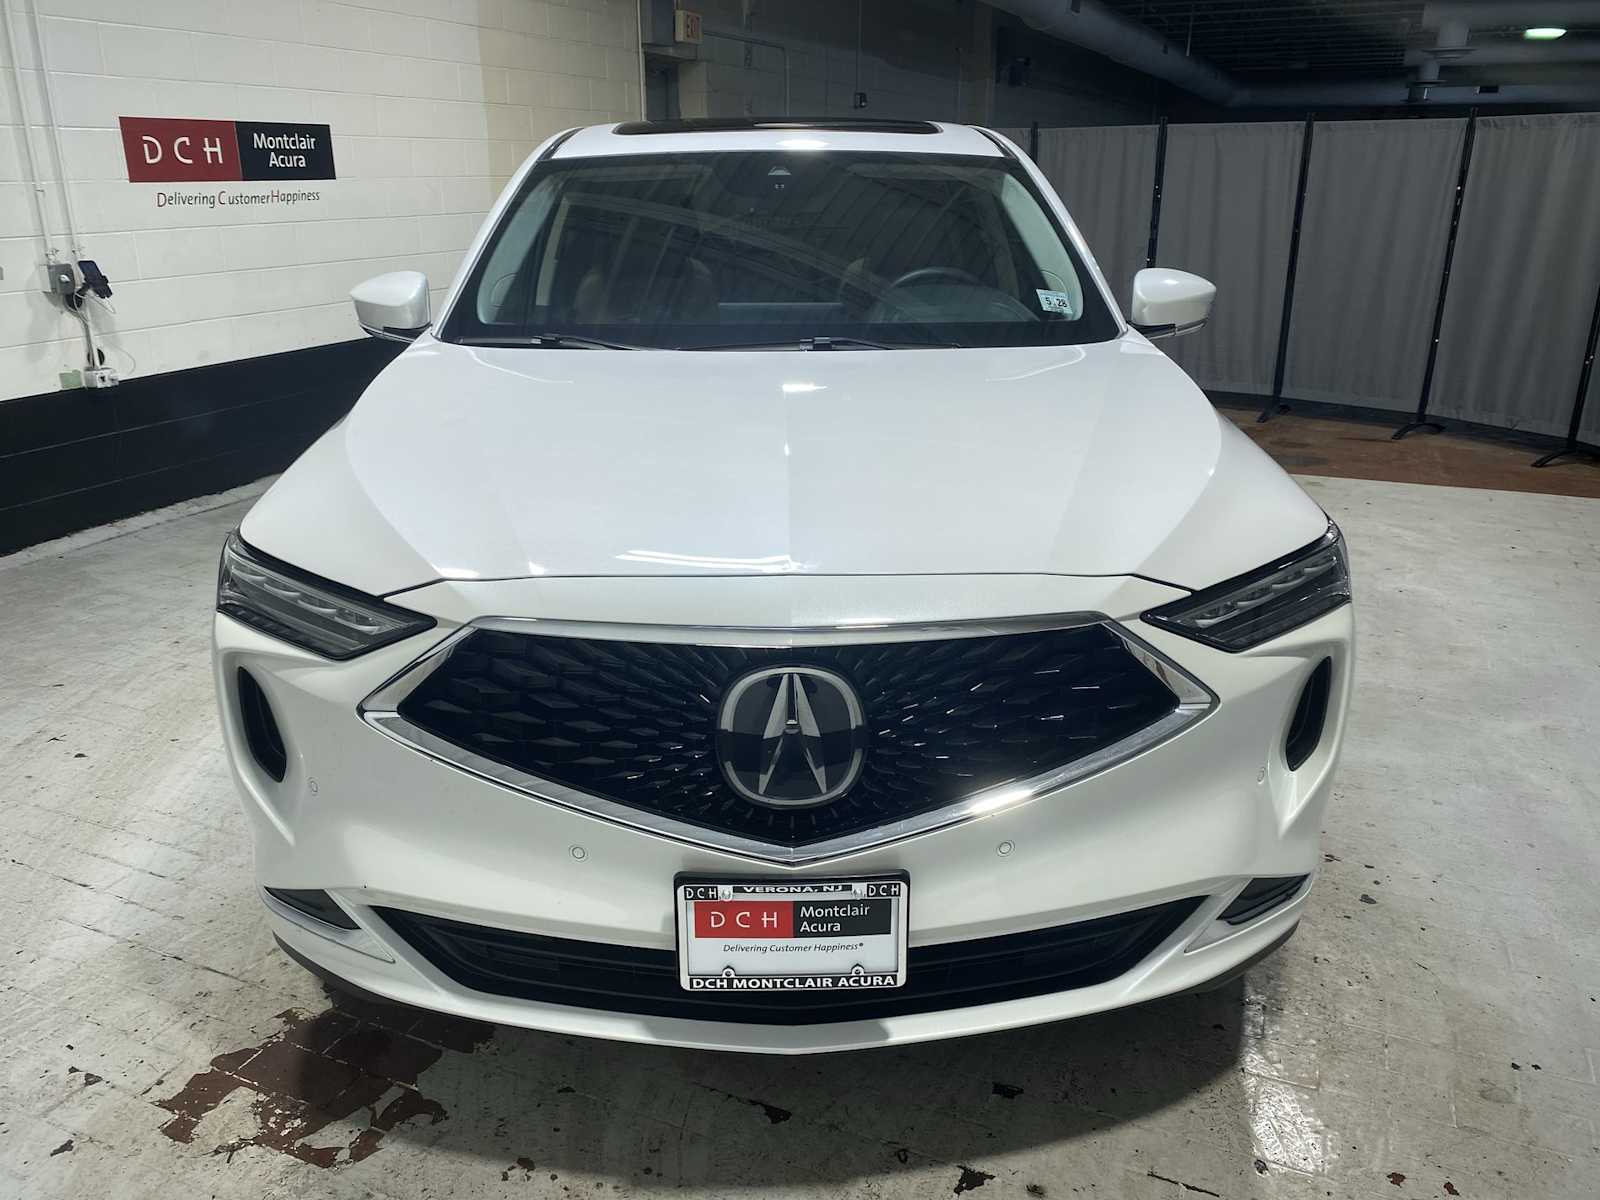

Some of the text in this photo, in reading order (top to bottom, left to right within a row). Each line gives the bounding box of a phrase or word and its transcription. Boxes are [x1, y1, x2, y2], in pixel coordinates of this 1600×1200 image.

[253, 133, 316, 150] Montclair
[142, 135, 223, 164] DCH
[269, 152, 306, 168] Acura
[157, 192, 215, 208] Delivering
[271, 190, 320, 206] Happiness
[686, 888, 717, 899] DCH
[868, 884, 900, 896] DCH
[800, 904, 870, 917] Montclair
[710, 911, 777, 928] DCH
[800, 921, 841, 932] Acura
[723, 944, 767, 954] Delivering
[769, 944, 812, 952] Customer
[692, 975, 895, 989] DCH MONTCLAIR ACURA
